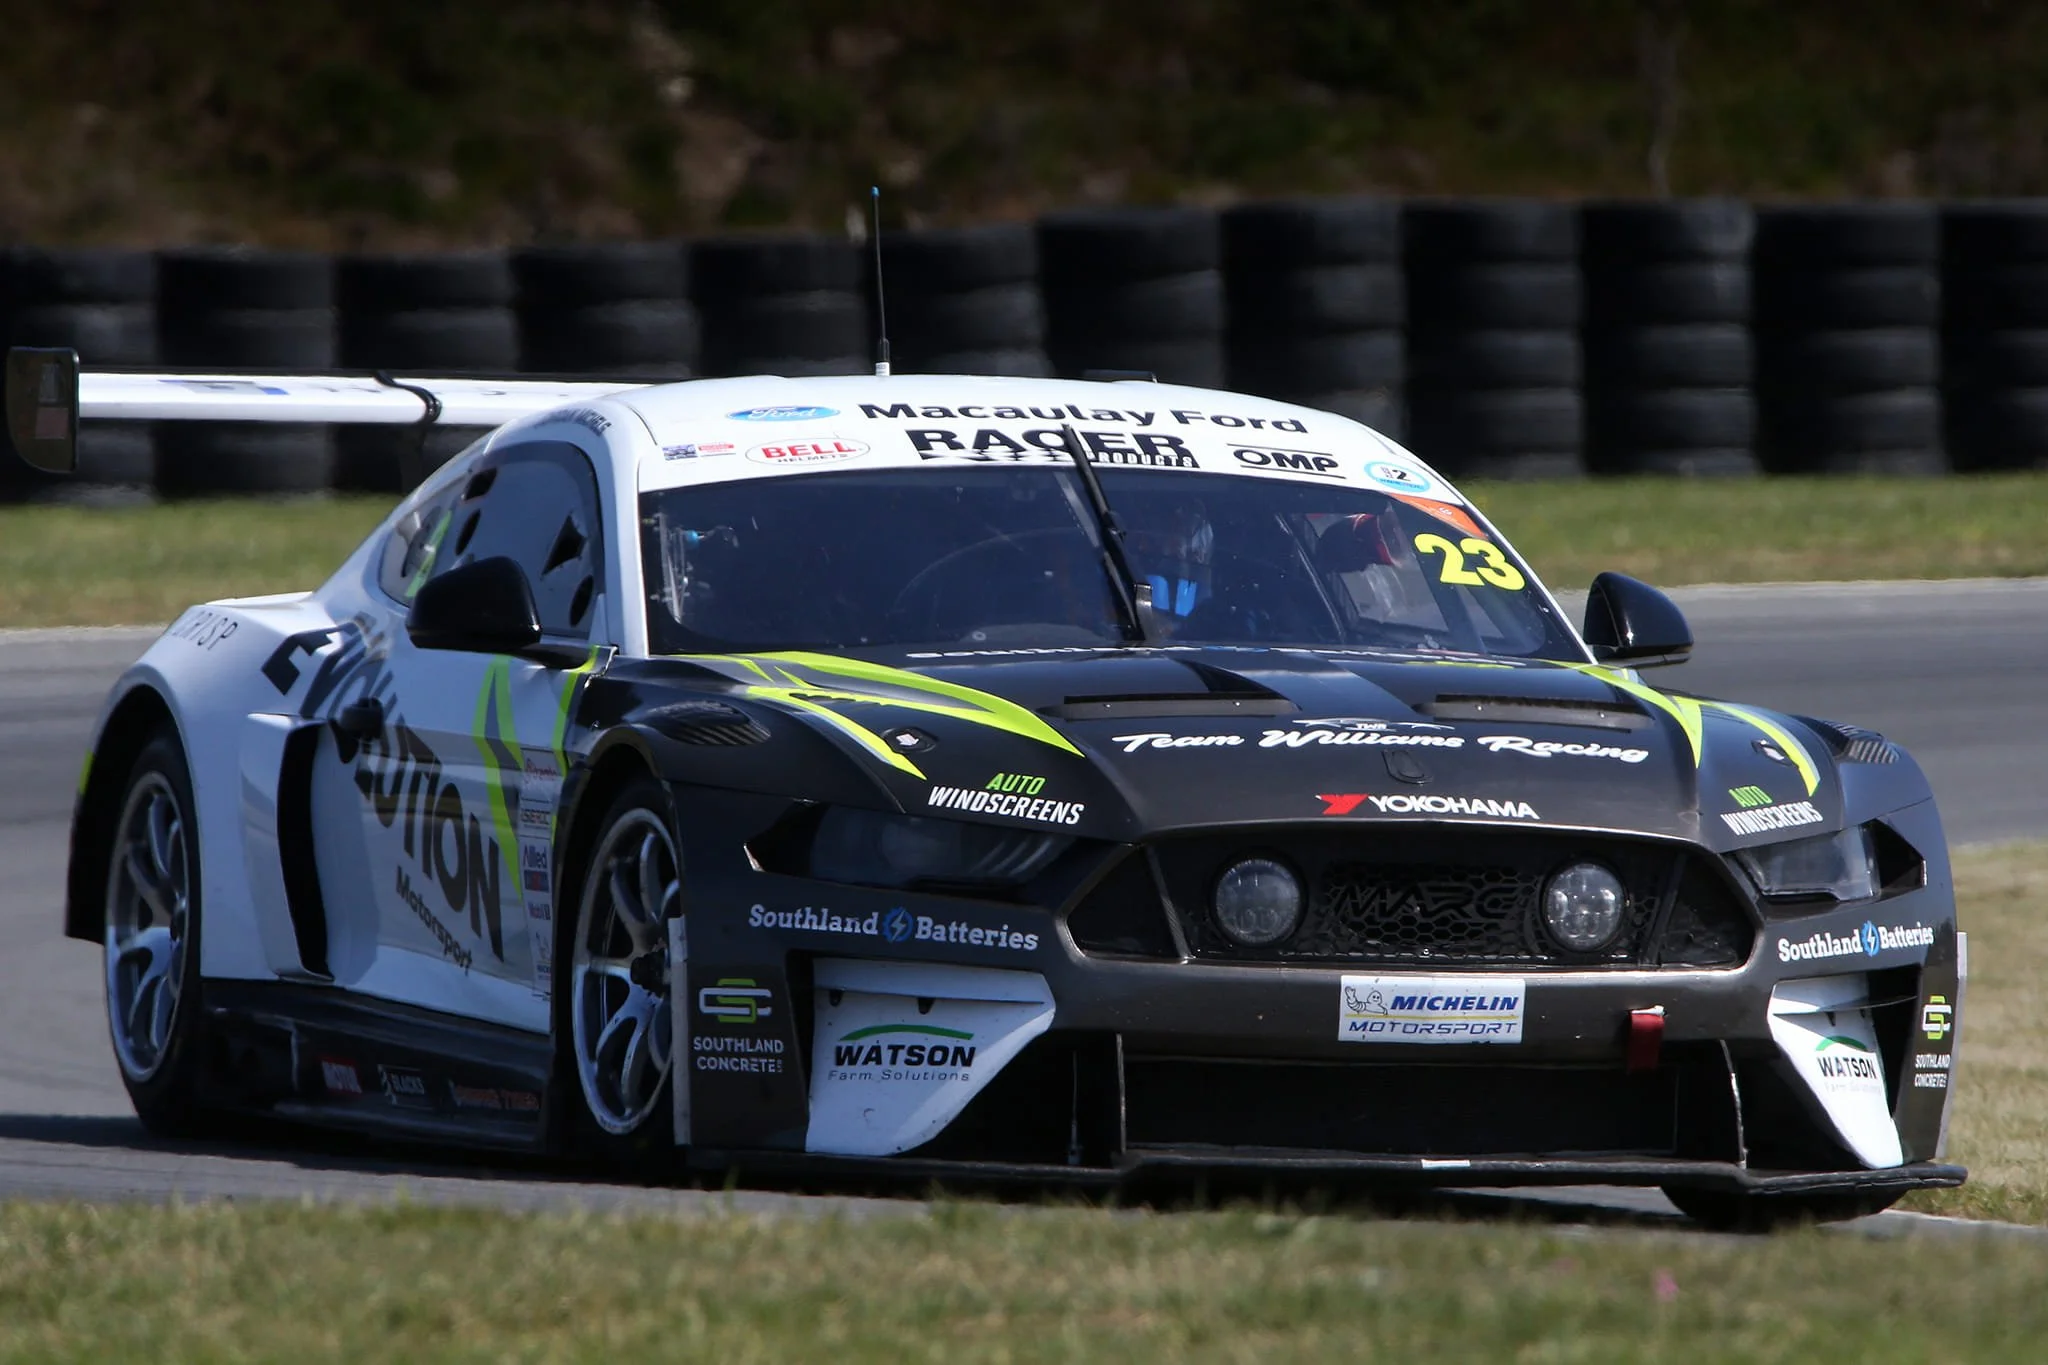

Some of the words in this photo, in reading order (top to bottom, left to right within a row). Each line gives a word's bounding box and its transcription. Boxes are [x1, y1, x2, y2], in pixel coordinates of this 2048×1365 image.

[750, 406, 817, 420] Ford
[858, 403, 1156, 426] Macaulay
[1169, 409, 1308, 434] Ford
[761, 441, 857, 459] BELL
[1232, 449, 1339, 472] OMP
[1413, 532, 1527, 592] 23
[1111, 732, 1244, 754] Team
[1256, 728, 1466, 750] Williams
[1477, 735, 1649, 763] Racing
[984, 772, 1047, 796] AUTO
[1727, 784, 1775, 808] AUTO
[927, 785, 1086, 826] WINDSCREENS
[1368, 794, 1541, 820] YOKOHAMA
[1719, 801, 1824, 837] WINDSCREENS
[395, 864, 473, 976] Motorsport
[747, 903, 879, 937] Southland
[914, 915, 1040, 951] Batteries
[1777, 930, 1864, 964] Southland
[1879, 921, 1935, 951] Batteries
[1389, 995, 1519, 1012] MICHELIN
[1348, 1020, 1518, 1037] MOTORSPORT
[692, 1036, 785, 1054] SOUTHLAND
[833, 1044, 977, 1069] WATSON
[696, 1056, 776, 1073] CONCRETE
[1817, 1055, 1879, 1080] WATSON
[1914, 1053, 1951, 1069] SOUTHLAND
[827, 1070, 872, 1081] Farm
[880, 1069, 971, 1083] Solutions
